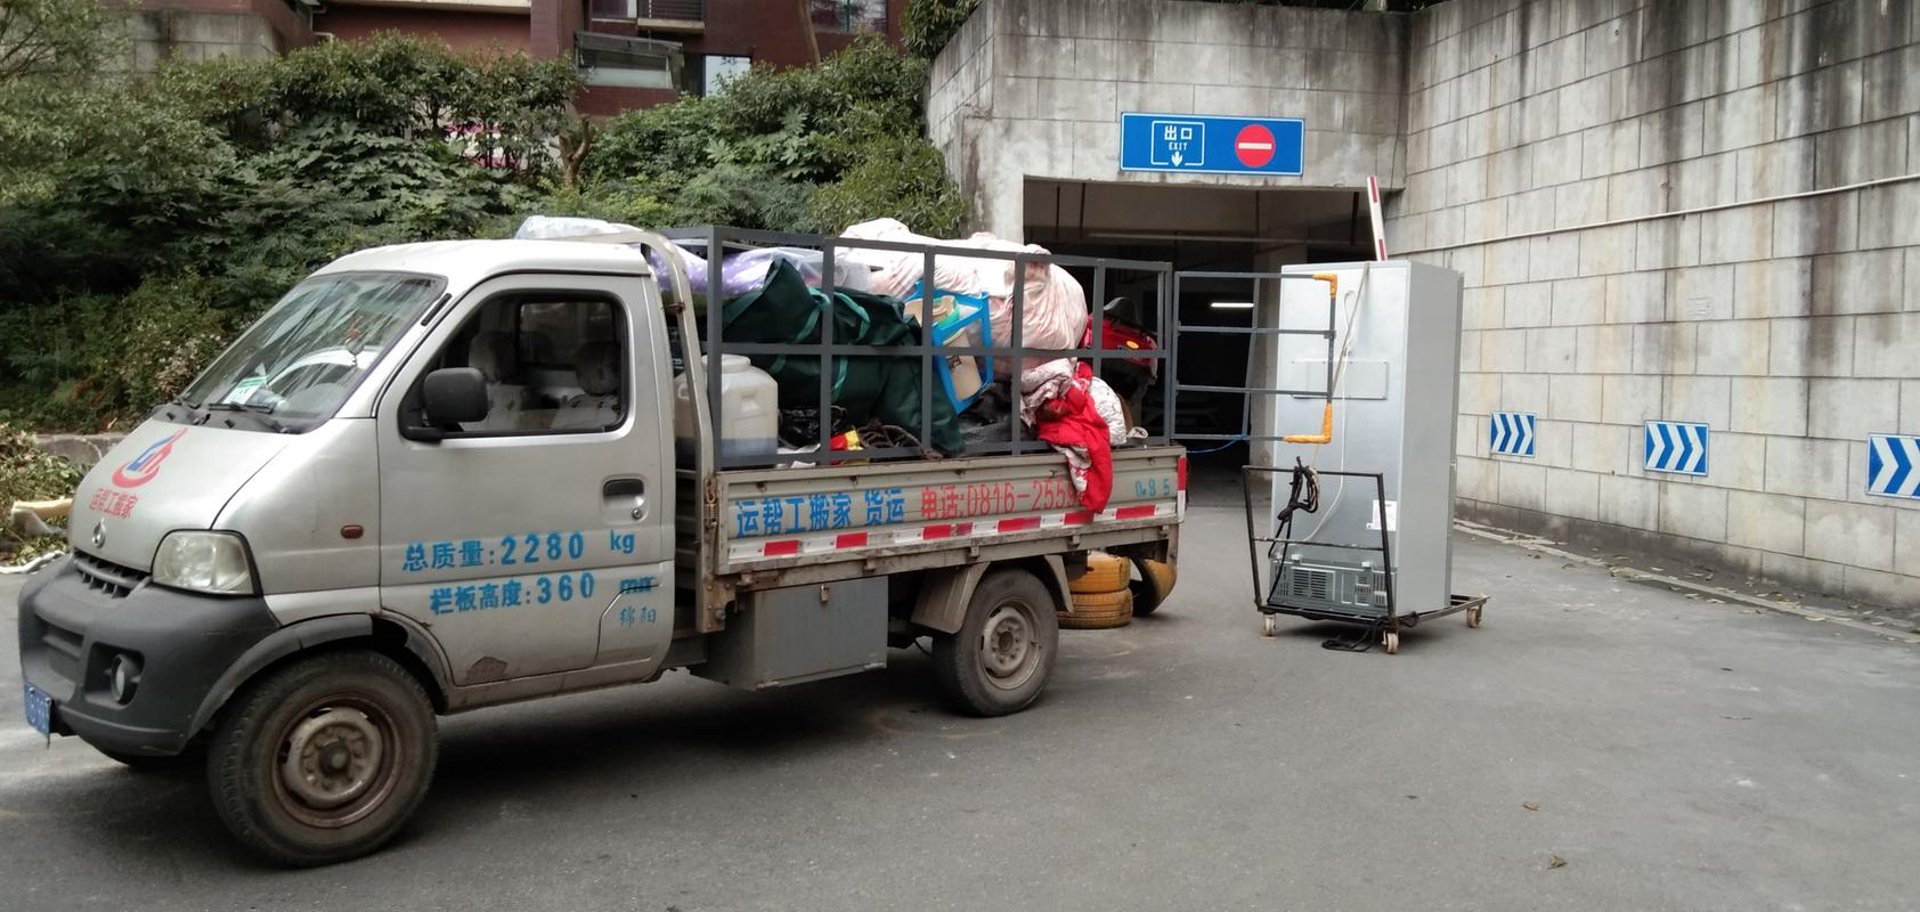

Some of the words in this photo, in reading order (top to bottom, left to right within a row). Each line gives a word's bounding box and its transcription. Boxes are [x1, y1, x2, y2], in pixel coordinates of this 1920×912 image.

[1164, 125, 1192, 140] 出口
[1168, 142, 1188, 151] EXIT
[89, 487, 138, 520] 运帮工搬家
[736, 492, 851, 538] 运帮工搬家
[863, 487, 906, 527] 货运
[610, 529, 635, 554] kg
